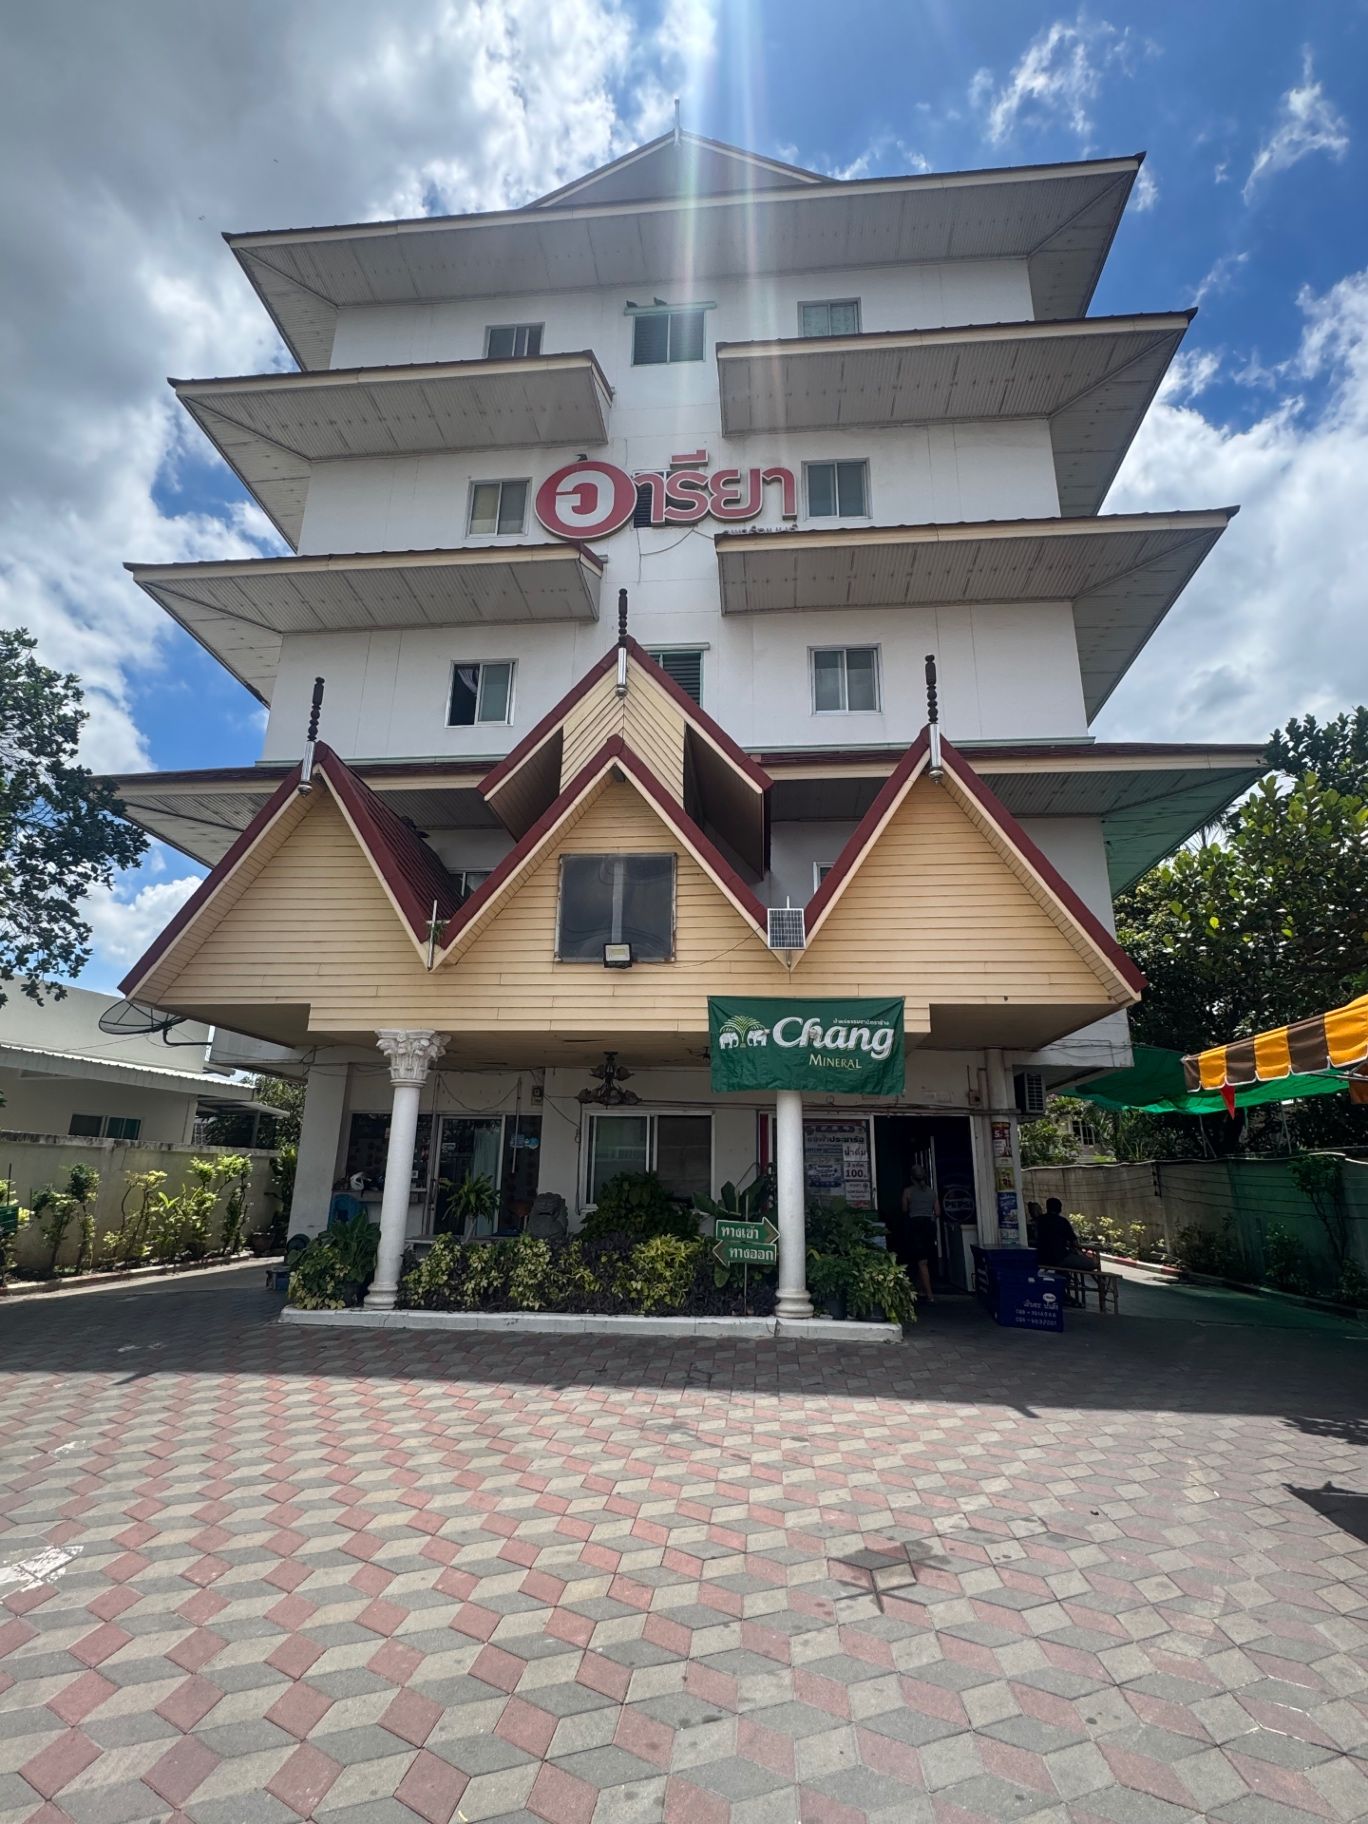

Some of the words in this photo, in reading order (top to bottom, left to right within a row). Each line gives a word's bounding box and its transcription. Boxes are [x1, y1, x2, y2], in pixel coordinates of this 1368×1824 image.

[535, 449, 798, 540] อารียา
[772, 1016, 895, 1060] Chang
[809, 1053, 863, 1071] MINERAL
[720, 1225, 759, 1240] ทางเข้า
[728, 1247, 774, 1261] ทางออก
